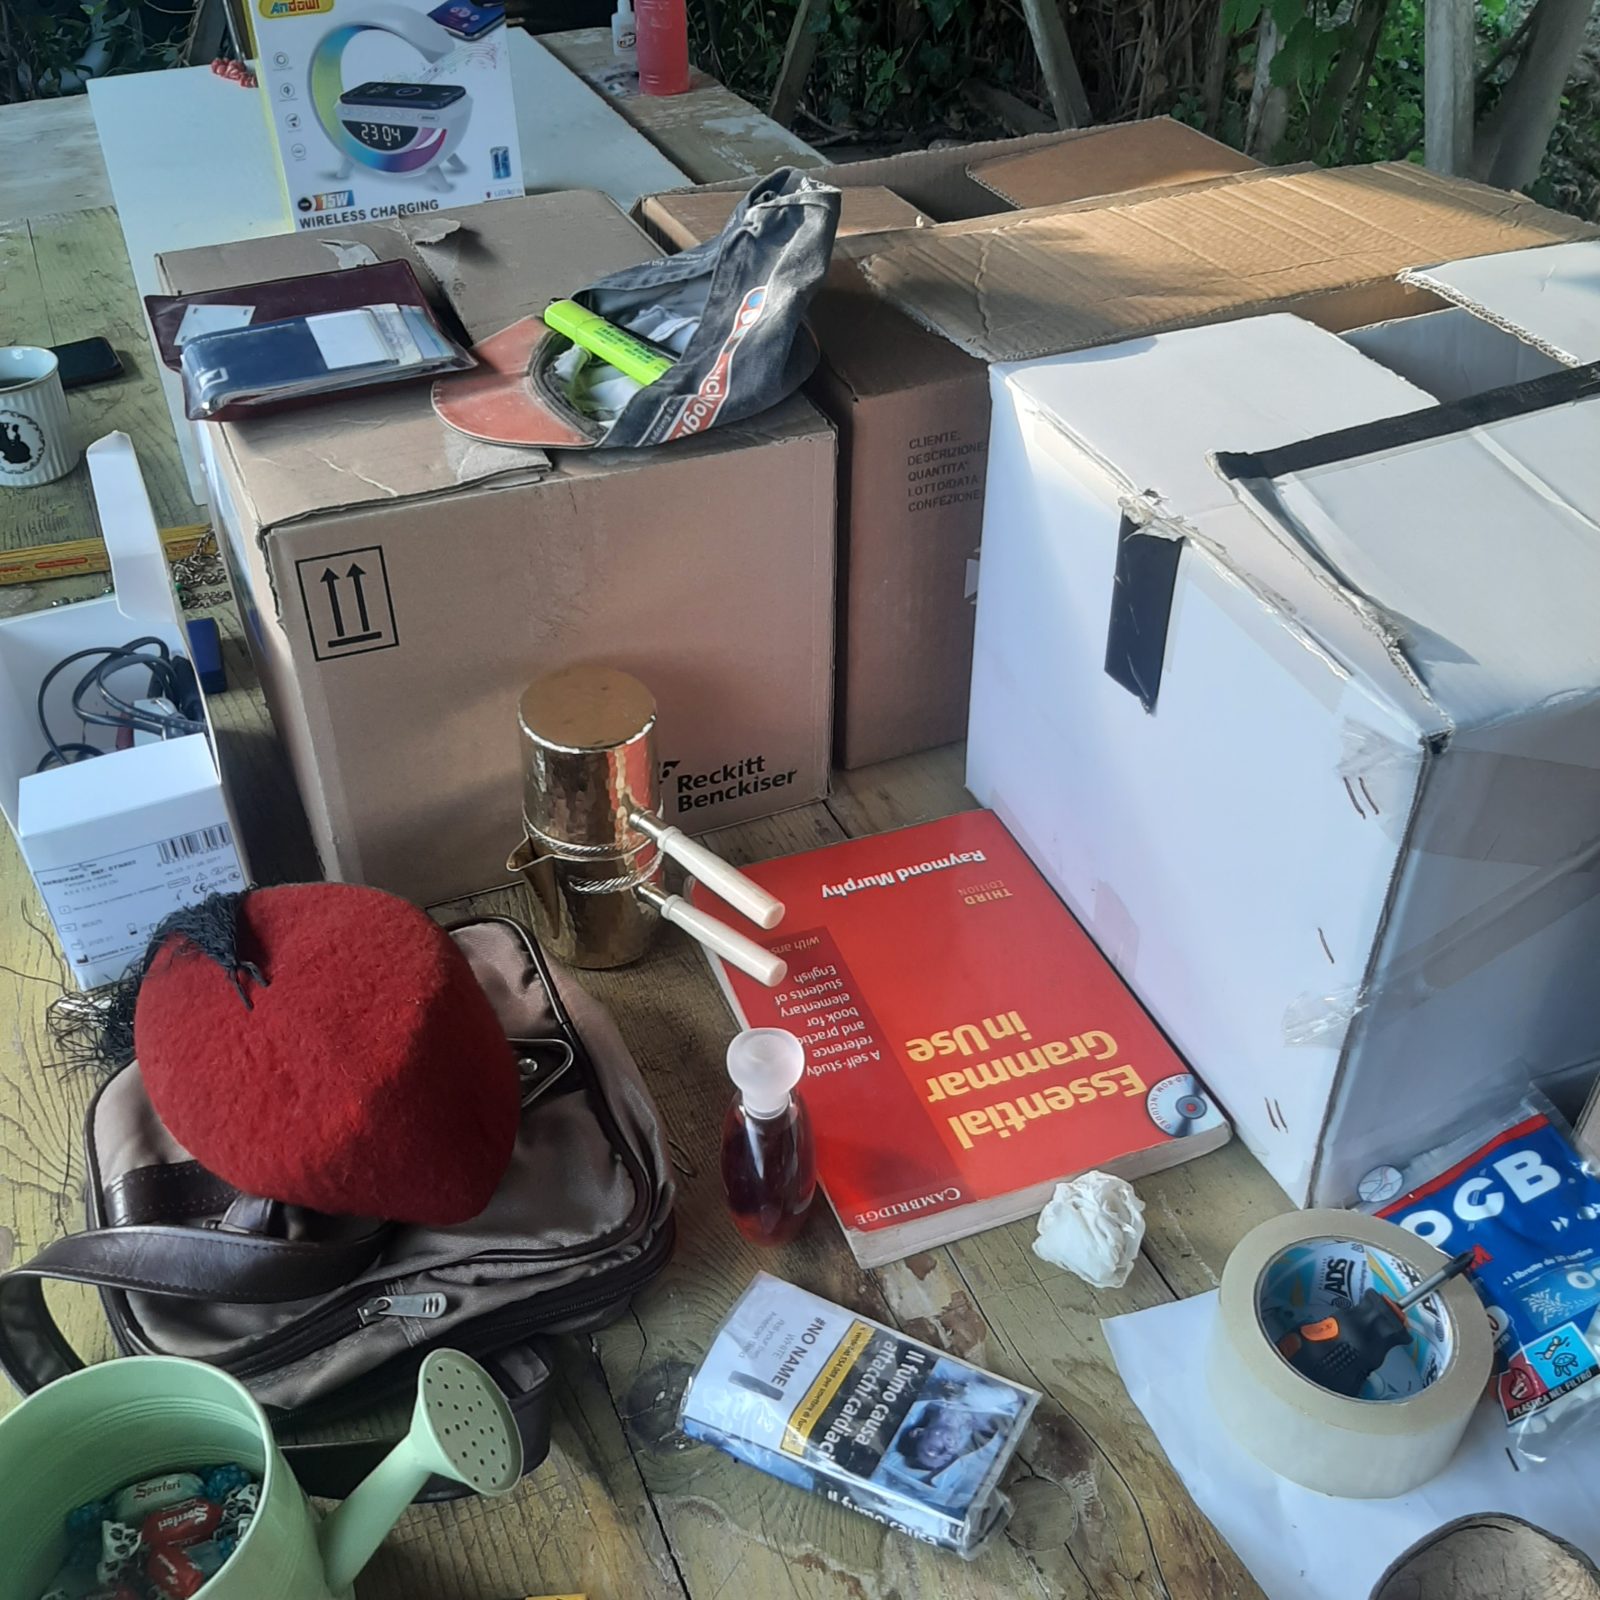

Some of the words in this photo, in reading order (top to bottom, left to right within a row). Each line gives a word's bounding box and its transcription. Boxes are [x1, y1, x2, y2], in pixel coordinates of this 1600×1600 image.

[321, 190, 350, 210] 15W
[299, 209, 366, 229] WIRELESS
[370, 199, 440, 218] CHARGING
[907, 441, 985, 466] DESCRIZIONE
[908, 489, 980, 512] CONFEZIONE
[677, 755, 765, 793] Reckitt
[678, 769, 797, 813] Benckiser
[896, 850, 987, 882] Raymond
[821, 871, 895, 898] Murphy
[957, 879, 1005, 897] EDITION
[963, 887, 1013, 905] THIRD
[794, 935, 820, 950] with
[793, 964, 837, 984] English
[774, 994, 788, 1006] of
[789, 978, 843, 1000] students
[780, 992, 850, 1018] elementary
[827, 1006, 859, 1024] book
[806, 1015, 826, 1027] for
[841, 1020, 866, 1037] and
[982, 1010, 1033, 1041] in
[798, 1025, 839, 1045] practic
[812, 1034, 873, 1058] reference
[905, 1024, 990, 1062] Use
[806, 1052, 869, 1077] self-study
[870, 1049, 881, 1061] A
[926, 1030, 1118, 1103] Grammar
[947, 1064, 1148, 1149] Essential
[1148, 1093, 1172, 1129] INCLUDED
[855, 1187, 961, 1225] CAMBRIDGE
[1400, 1149, 1562, 1252] OCB
[1324, 1258, 1349, 1298] ADS
[801, 1316, 828, 1345] #NO
[772, 1333, 797, 1360] WHITE
[904, 1350, 926, 1364] Il
[770, 1345, 809, 1387] NAME
[853, 1340, 898, 1400] attacchi
[881, 1363, 920, 1402] fumo
[819, 1397, 863, 1461] cardiaci
[854, 1403, 890, 1446] causa
